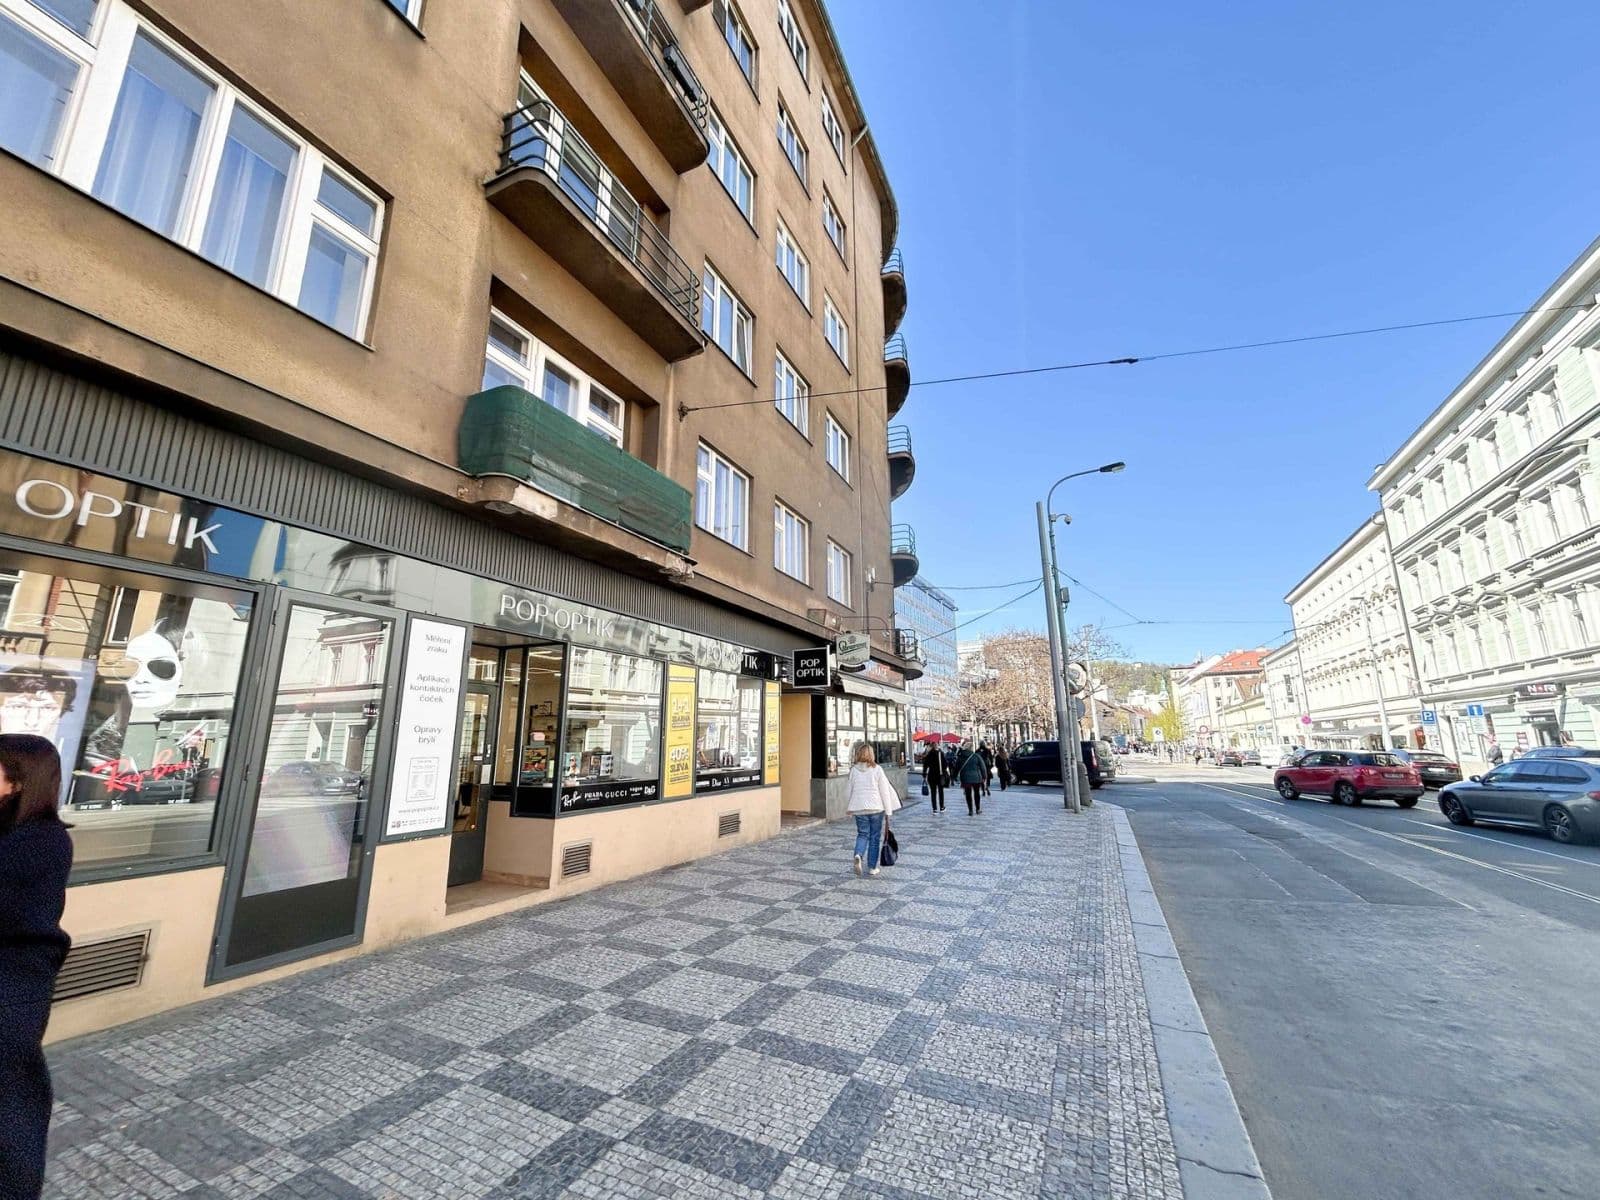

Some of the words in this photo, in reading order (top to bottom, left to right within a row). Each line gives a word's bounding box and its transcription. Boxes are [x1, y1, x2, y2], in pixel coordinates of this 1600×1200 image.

[15, 479, 223, 555] OPTIK
[500, 594, 549, 624] POP
[554, 608, 614, 638] OPTIK
[800, 658, 820, 667] POP
[796, 667, 825, 678] OPTIK
[416, 673, 450, 684] Aplikace
[413, 725, 442, 736] Opravy
[605, 789, 628, 799] GUCCI
